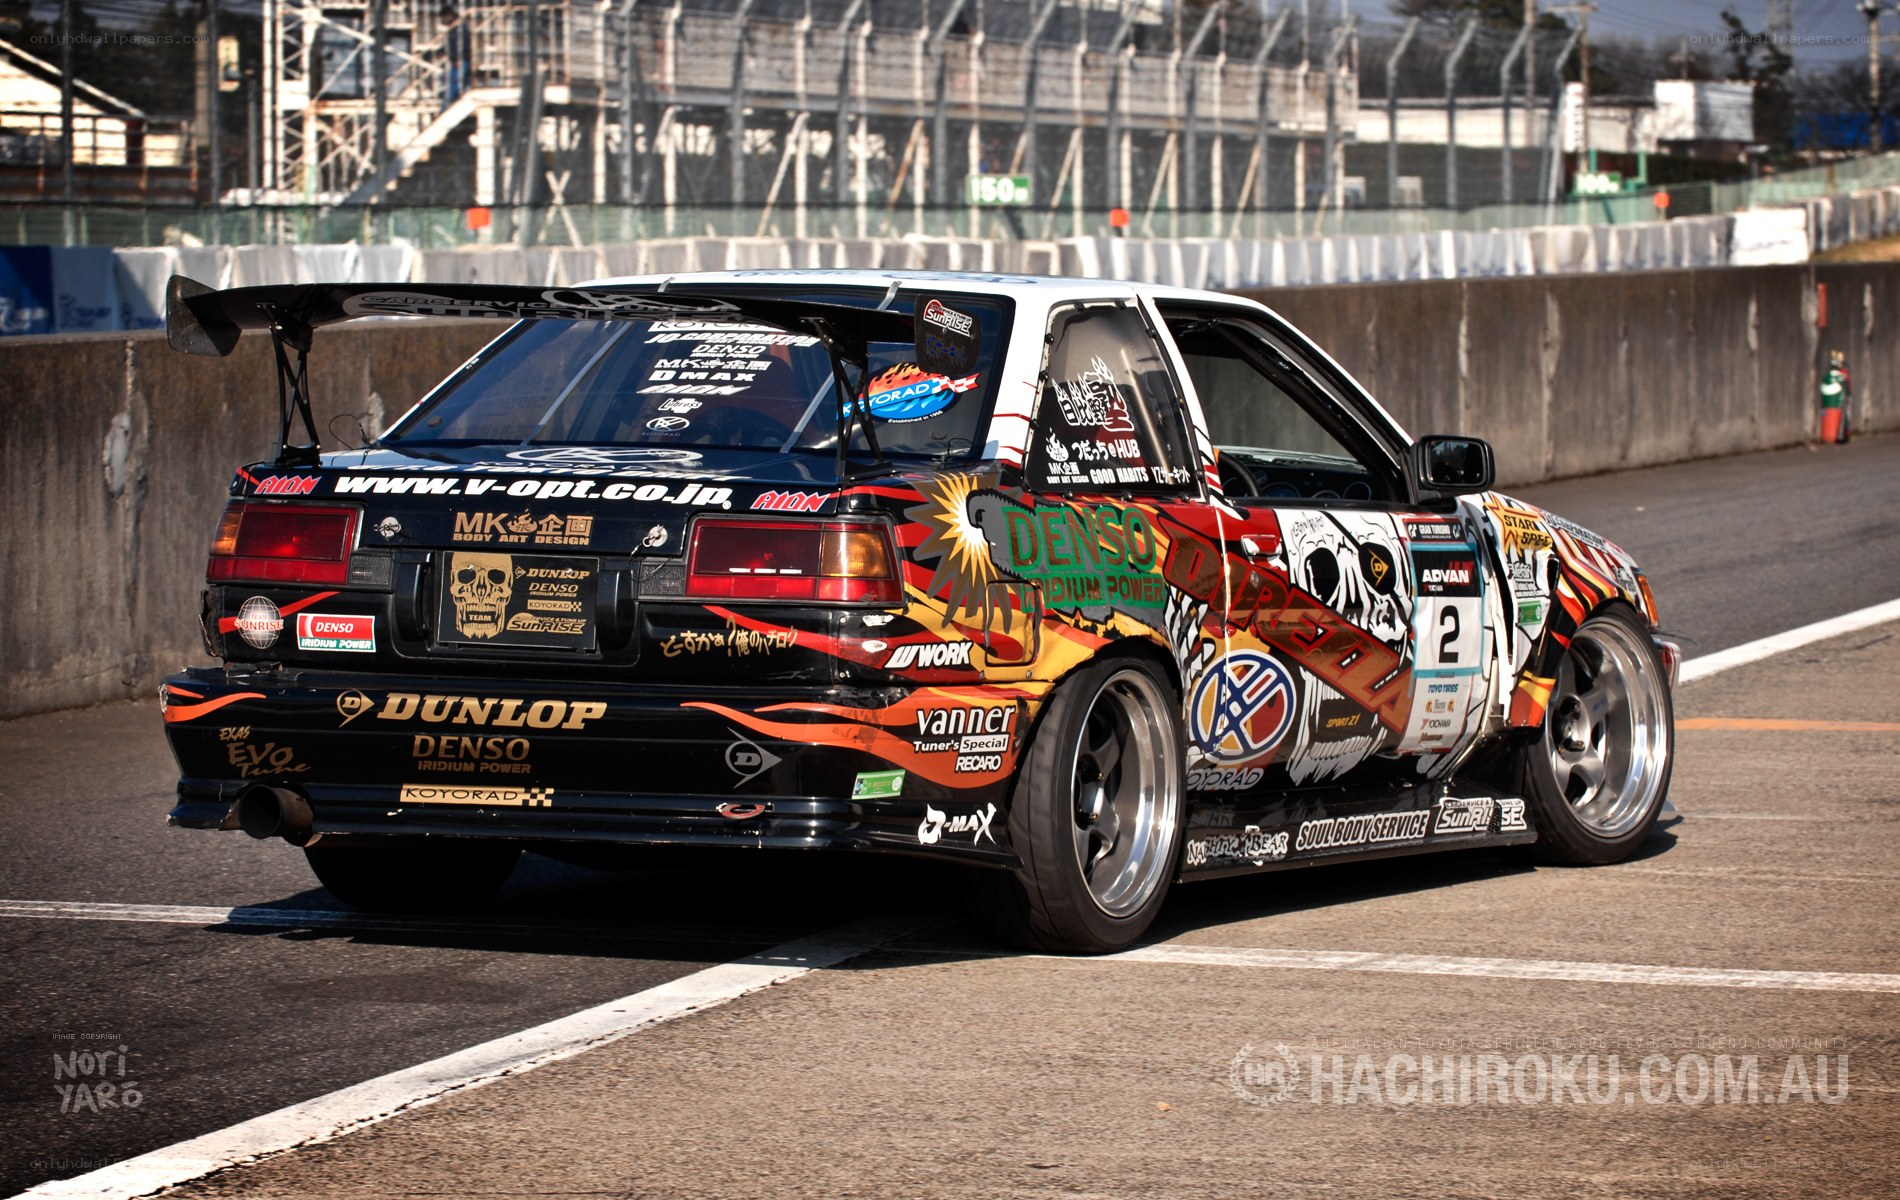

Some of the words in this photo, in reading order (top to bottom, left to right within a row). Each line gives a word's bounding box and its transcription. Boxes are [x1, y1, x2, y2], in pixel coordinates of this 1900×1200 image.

[691, 344, 767, 354] DENSO
[654, 358, 702, 368] MK
[1089, 468, 1116, 485] GOOD
[1116, 466, 1150, 483] HABITS
[253, 475, 323, 495] AION
[334, 476, 733, 505] www.v-opt.co.jp
[750, 490, 831, 512] AION
[454, 511, 509, 535] MK
[536, 513, 594, 537] 企画
[453, 533, 492, 542] BODY
[498, 534, 529, 543] ART
[534, 535, 590, 546] DESIGN
[1002, 506, 1157, 571] DENSO
[526, 568, 590, 580] DUNLOP
[1422, 569, 1470, 583] ADVAN
[528, 582, 579, 593] DENSO
[1104, 573, 1167, 609] POWER
[233, 618, 285, 631] SUNRISE
[468, 614, 492, 622] TEAM
[509, 619, 586, 632] SunRISE
[315, 621, 354, 633] DENSO
[1438, 604, 1460, 663] 2
[301, 638, 337, 648] IRIDIUM
[338, 639, 373, 650] POWER
[916, 641, 973, 668] WORK
[377, 692, 608, 730] DUNLOP
[1326, 715, 1350, 728] SPORT
[412, 734, 530, 761] DENSO
[914, 740, 960, 752] Tuner's
[963, 737, 1007, 750] Special
[226, 741, 294, 767] EVO
[235, 761, 312, 778] Tune
[418, 760, 475, 773] IRIDIUM
[479, 761, 531, 774] POWER
[955, 755, 1002, 773] RECARO
[405, 787, 518, 801] KOYORAD
[1297, 820, 1333, 849] SOUL
[1332, 816, 1374, 845] BODY
[1371, 811, 1430, 841] SERVICE
